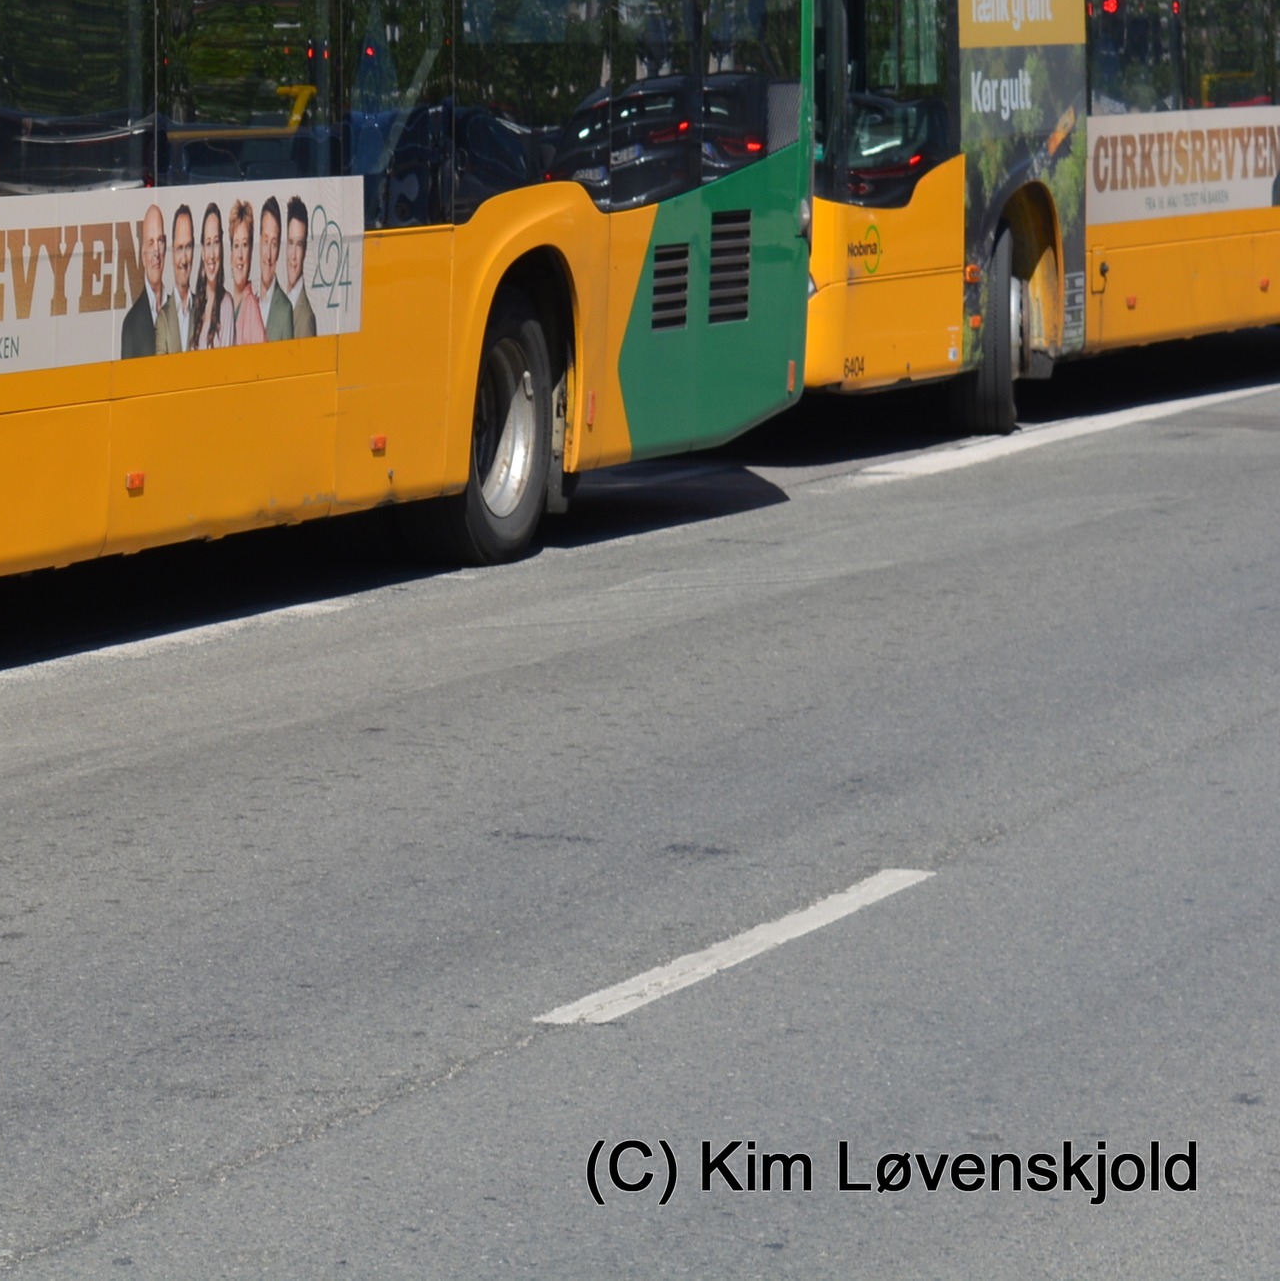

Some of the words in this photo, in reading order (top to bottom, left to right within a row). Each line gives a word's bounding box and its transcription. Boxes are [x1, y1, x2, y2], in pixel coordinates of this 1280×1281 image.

[971, 70, 998, 113] Kør
[1000, 69, 1033, 120] gult
[1092, 124, 1280, 193] CIRKUSREVYEN
[848, 240, 878, 258] Nobina
[843, 356, 865, 379] 6404
